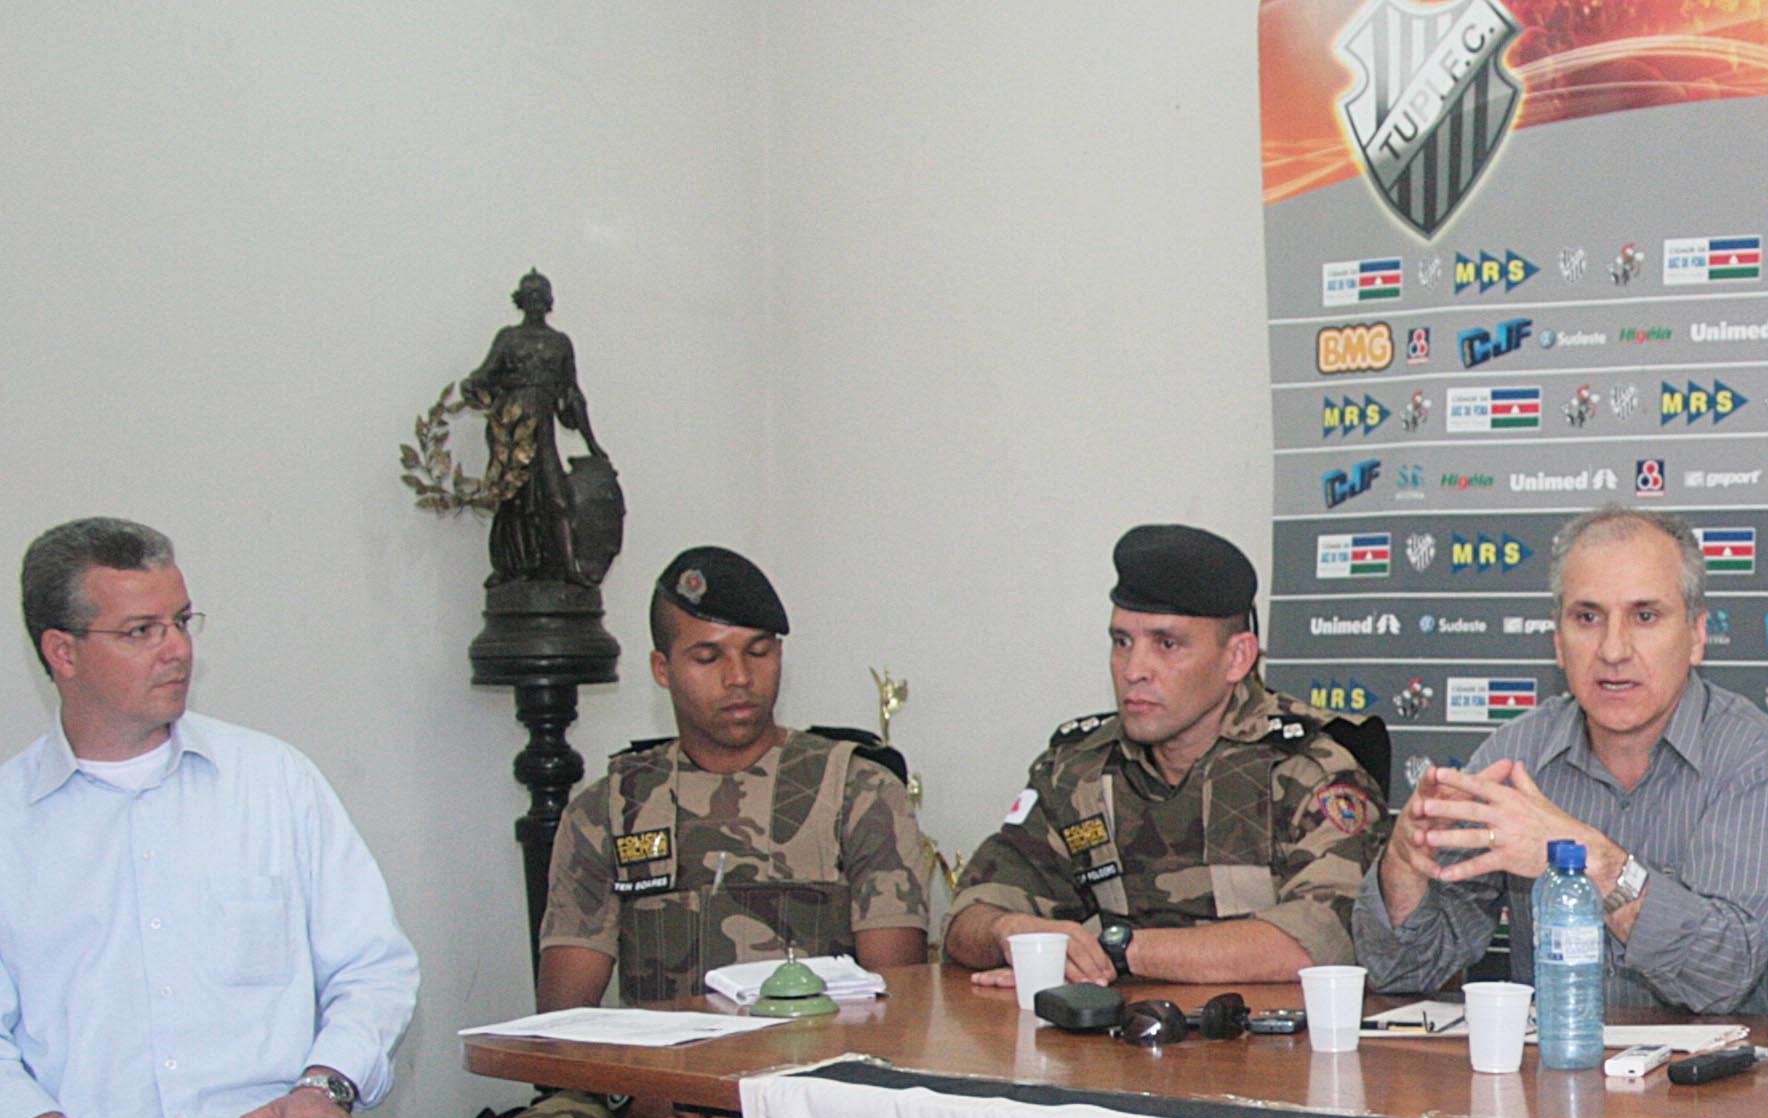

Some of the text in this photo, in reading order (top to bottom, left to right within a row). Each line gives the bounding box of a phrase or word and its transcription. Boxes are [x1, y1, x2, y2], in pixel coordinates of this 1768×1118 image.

[1457, 259, 1525, 282] MRS
[1319, 325, 1392, 372] BMG
[1558, 331, 1606, 346] Sudeste
[1663, 392, 1732, 414] MRS
[1325, 405, 1379, 427] MRS
[1510, 471, 1589, 491] Unimed
[1453, 543, 1520, 565] MRS
[1311, 618, 1372, 636] Unimed
[1439, 618, 1486, 633] Sudeste
[1311, 688, 1365, 709] MRS
